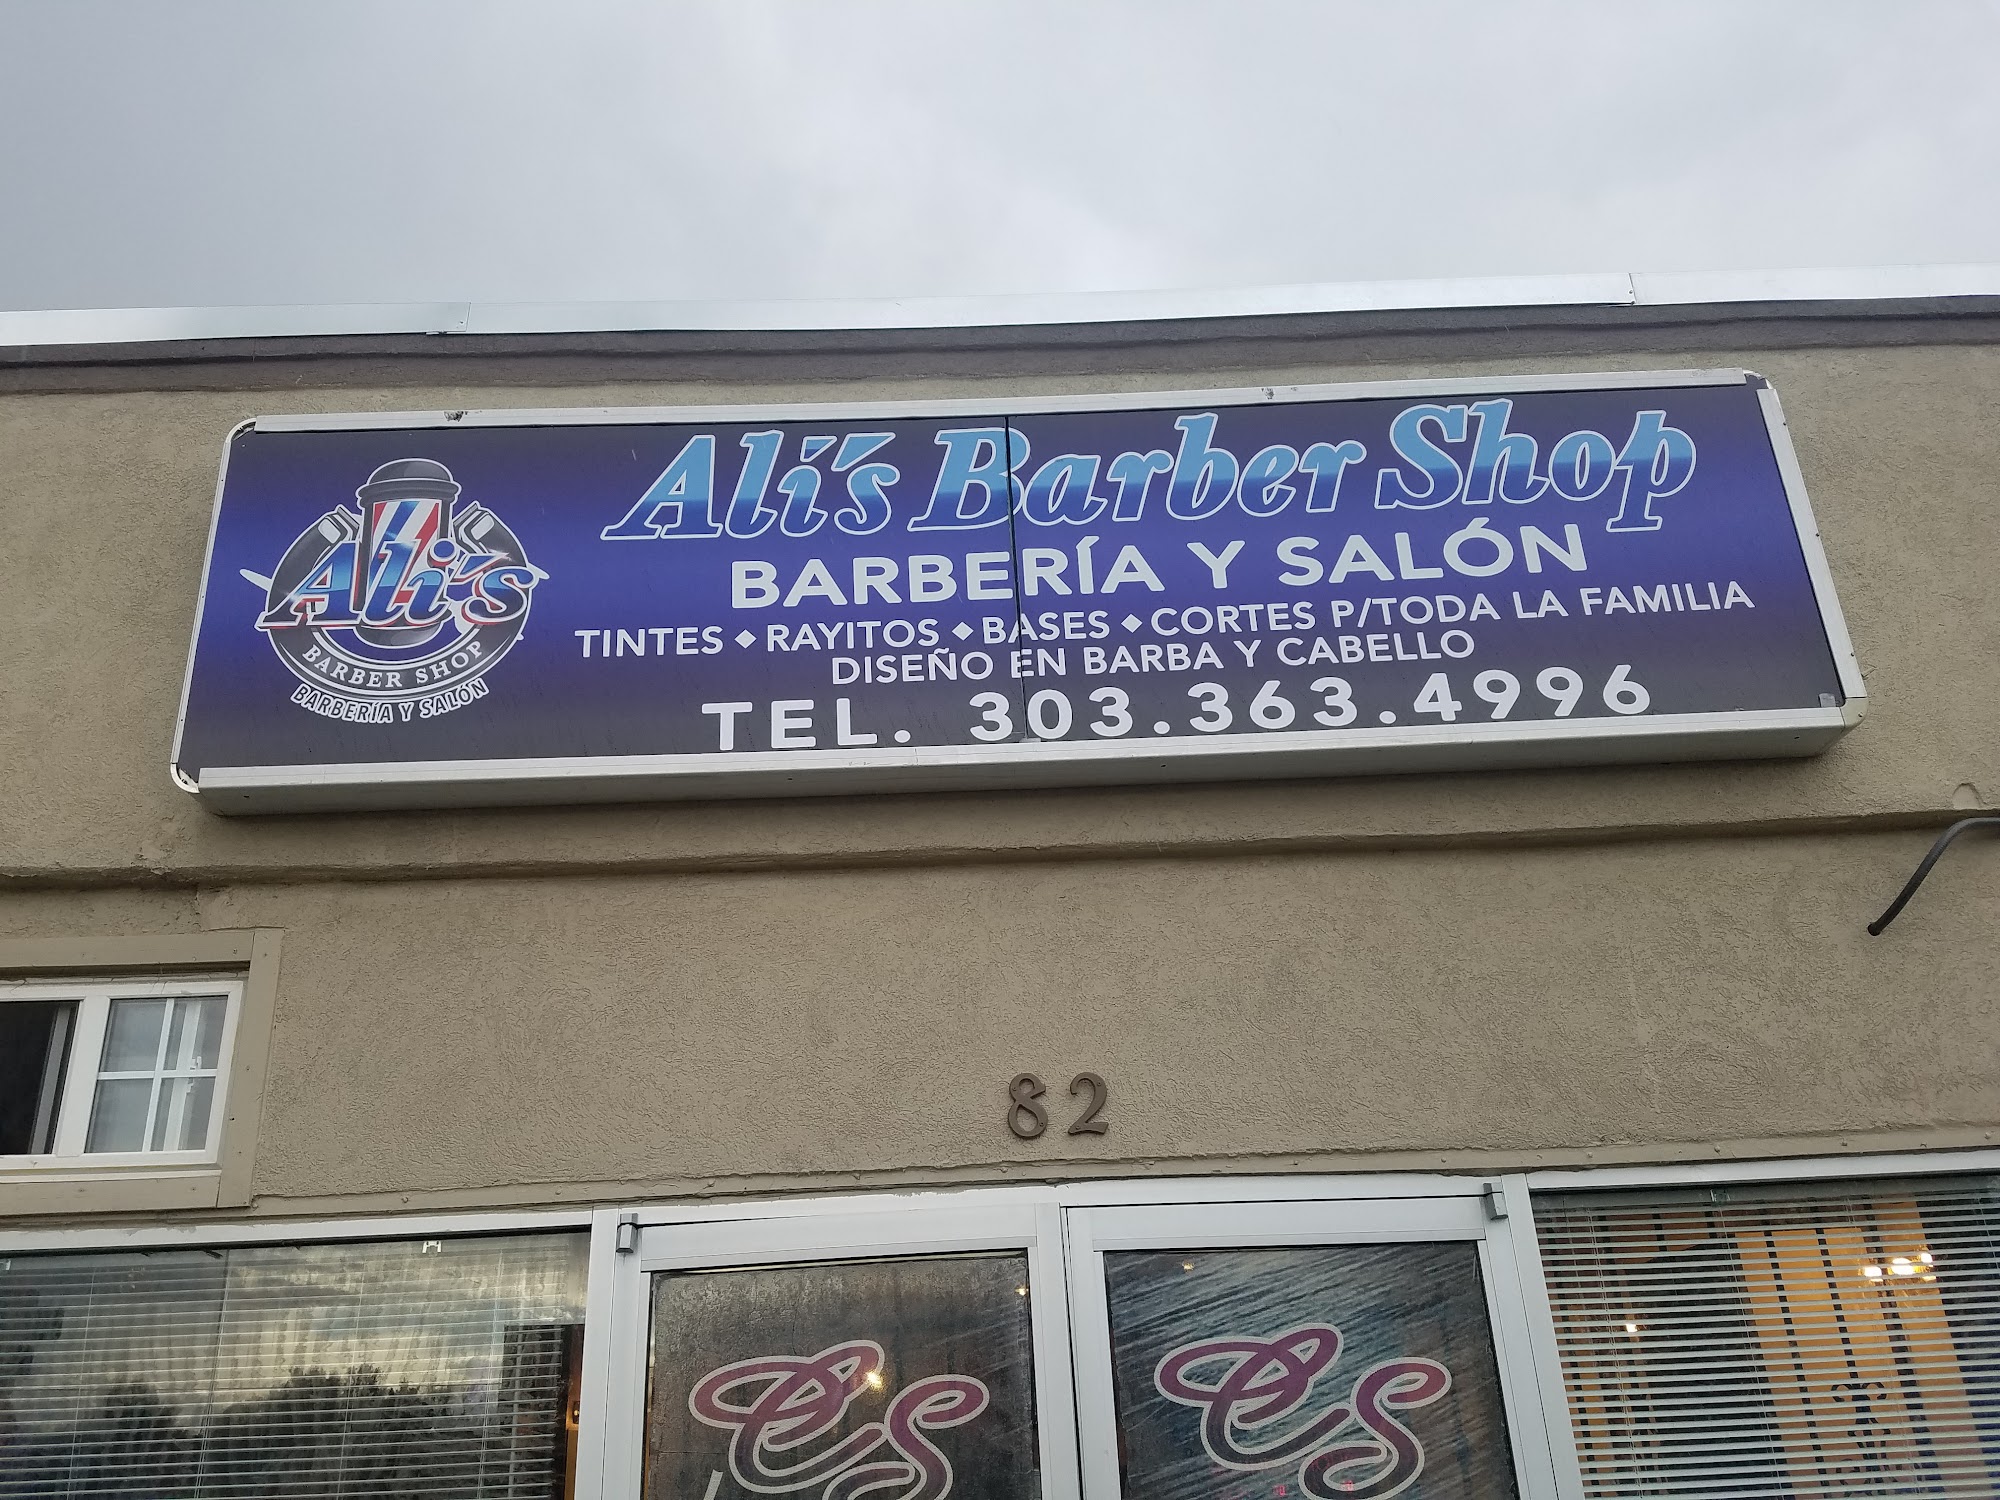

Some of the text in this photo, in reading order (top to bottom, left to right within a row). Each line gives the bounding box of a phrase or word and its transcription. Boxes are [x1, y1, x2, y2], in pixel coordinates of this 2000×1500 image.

[600, 398, 1697, 541] Ali's Barber Shop
[254, 537, 537, 631] Ali's
[731, 517, 1588, 609] BARBERÍA Y SALÓN
[574, 580, 1756, 658] TINTES RAYITOS BASES CORTES P/TODA LA FAMILIA
[832, 629, 1476, 685] DISEÑO EN BARBA Y CABELLO
[290, 677, 489, 724] BARBERÍA Y SALÓN
[302, 640, 485, 689] BARBER SHOP
[701, 664, 1651, 751] TEL. 303.363.4996
[1007, 1071, 1109, 1139] 82
